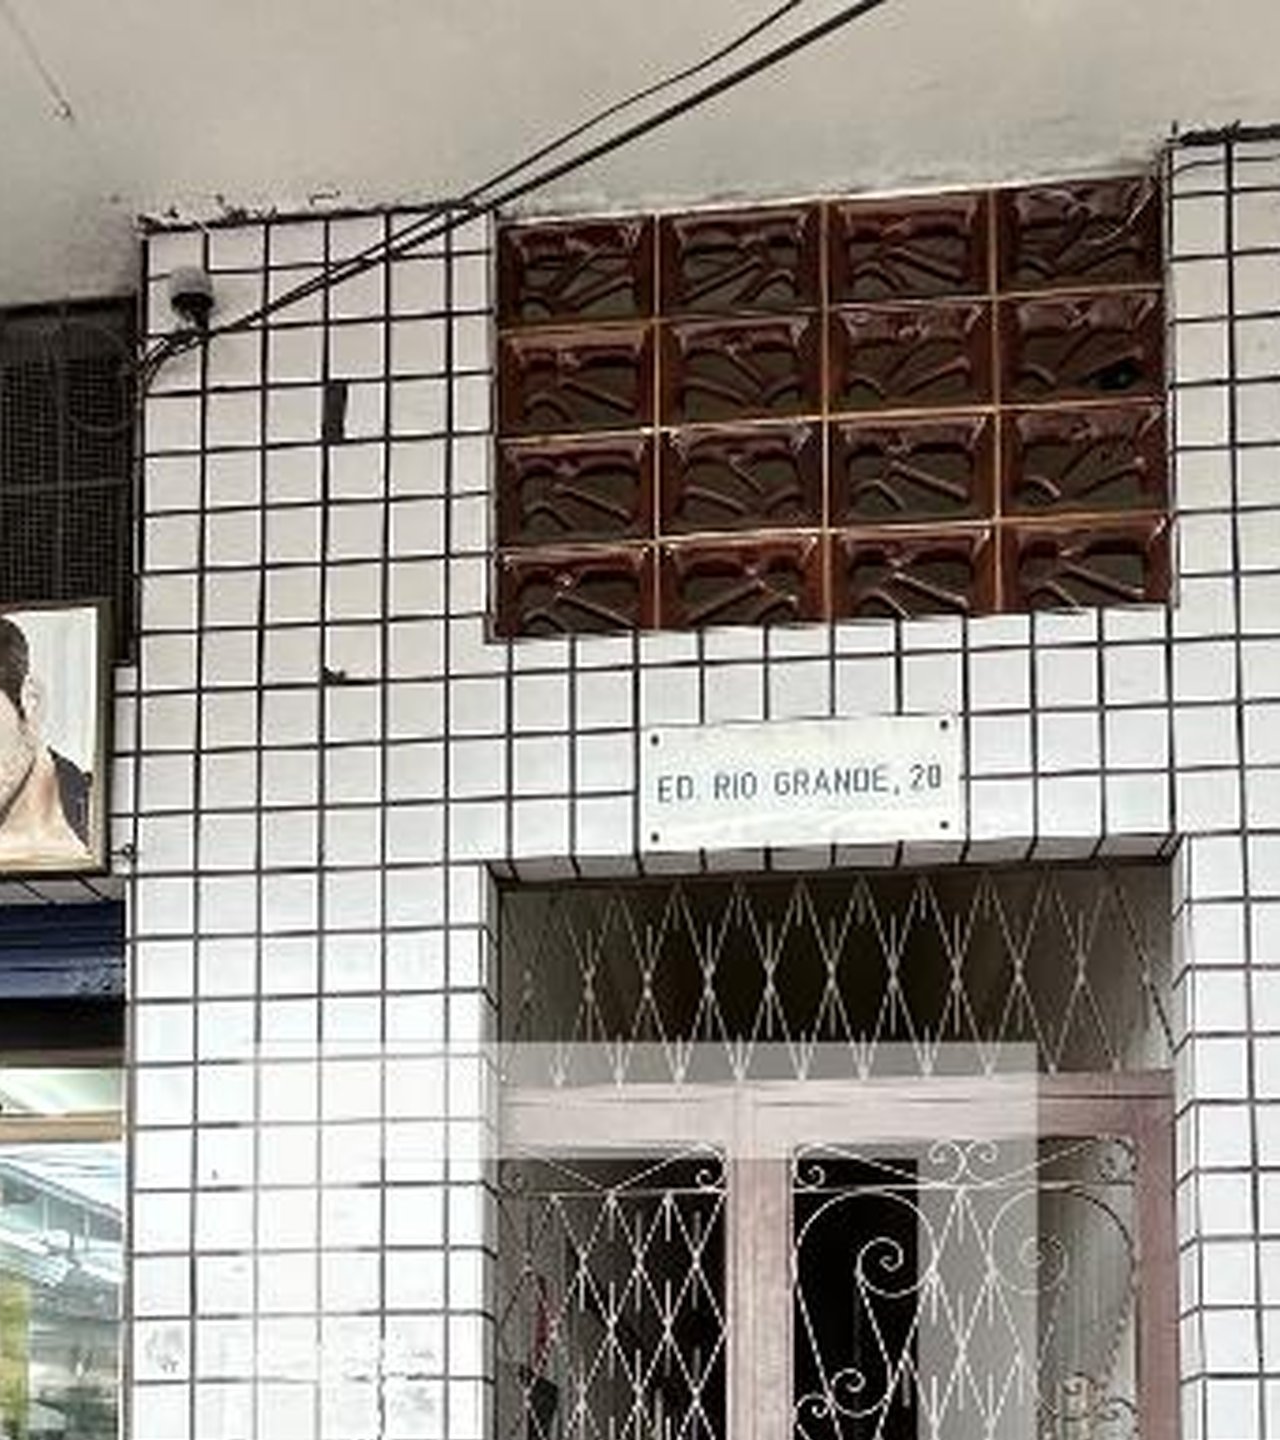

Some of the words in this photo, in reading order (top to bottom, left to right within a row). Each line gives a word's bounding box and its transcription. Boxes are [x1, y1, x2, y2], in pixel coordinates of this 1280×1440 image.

[714, 771, 757, 801] RIO
[773, 764, 901, 797] GRANDE,
[909, 763, 942, 791] 20
